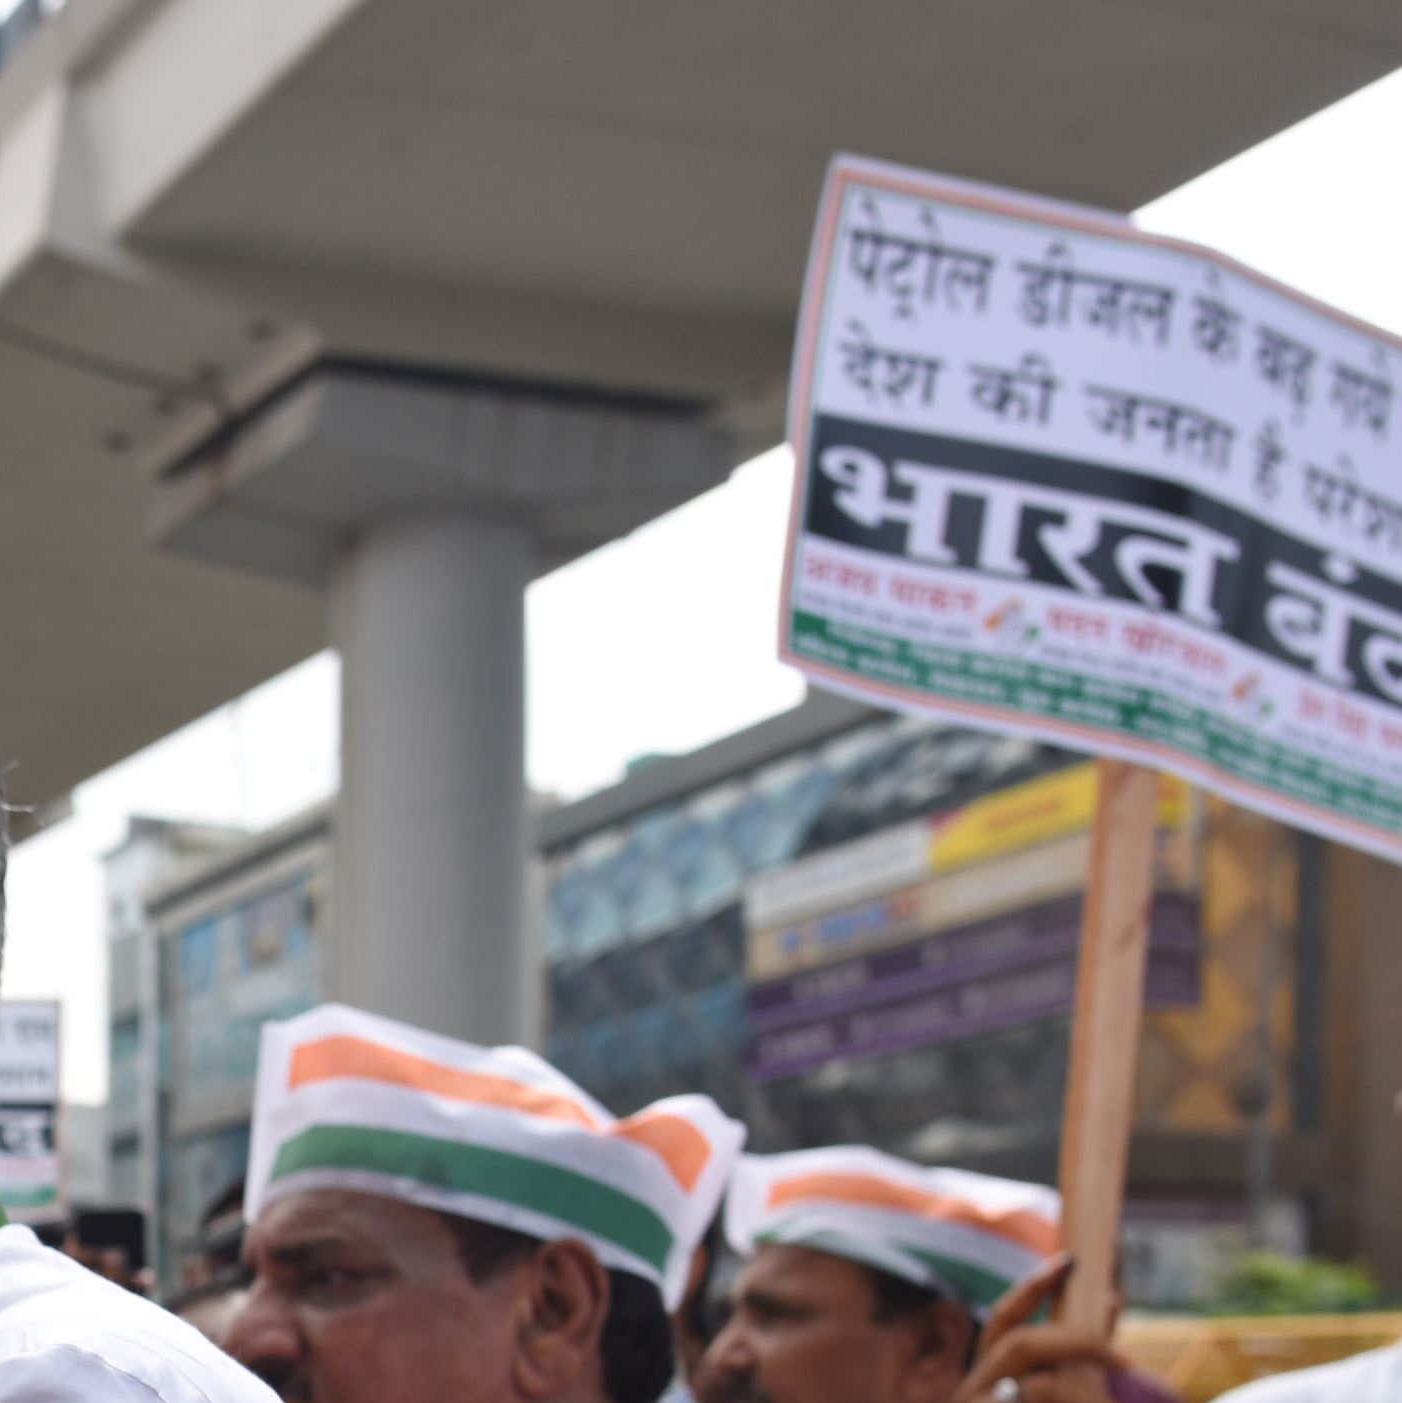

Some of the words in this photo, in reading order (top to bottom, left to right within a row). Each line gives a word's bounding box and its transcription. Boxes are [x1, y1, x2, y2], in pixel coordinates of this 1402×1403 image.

[845, 192, 994, 320] पेट्रोल
[837, 316, 943, 408] देश
[967, 352, 1061, 428] की
[1083, 382, 1238, 474] जनता
[819, 443, 1242, 632] भारत
